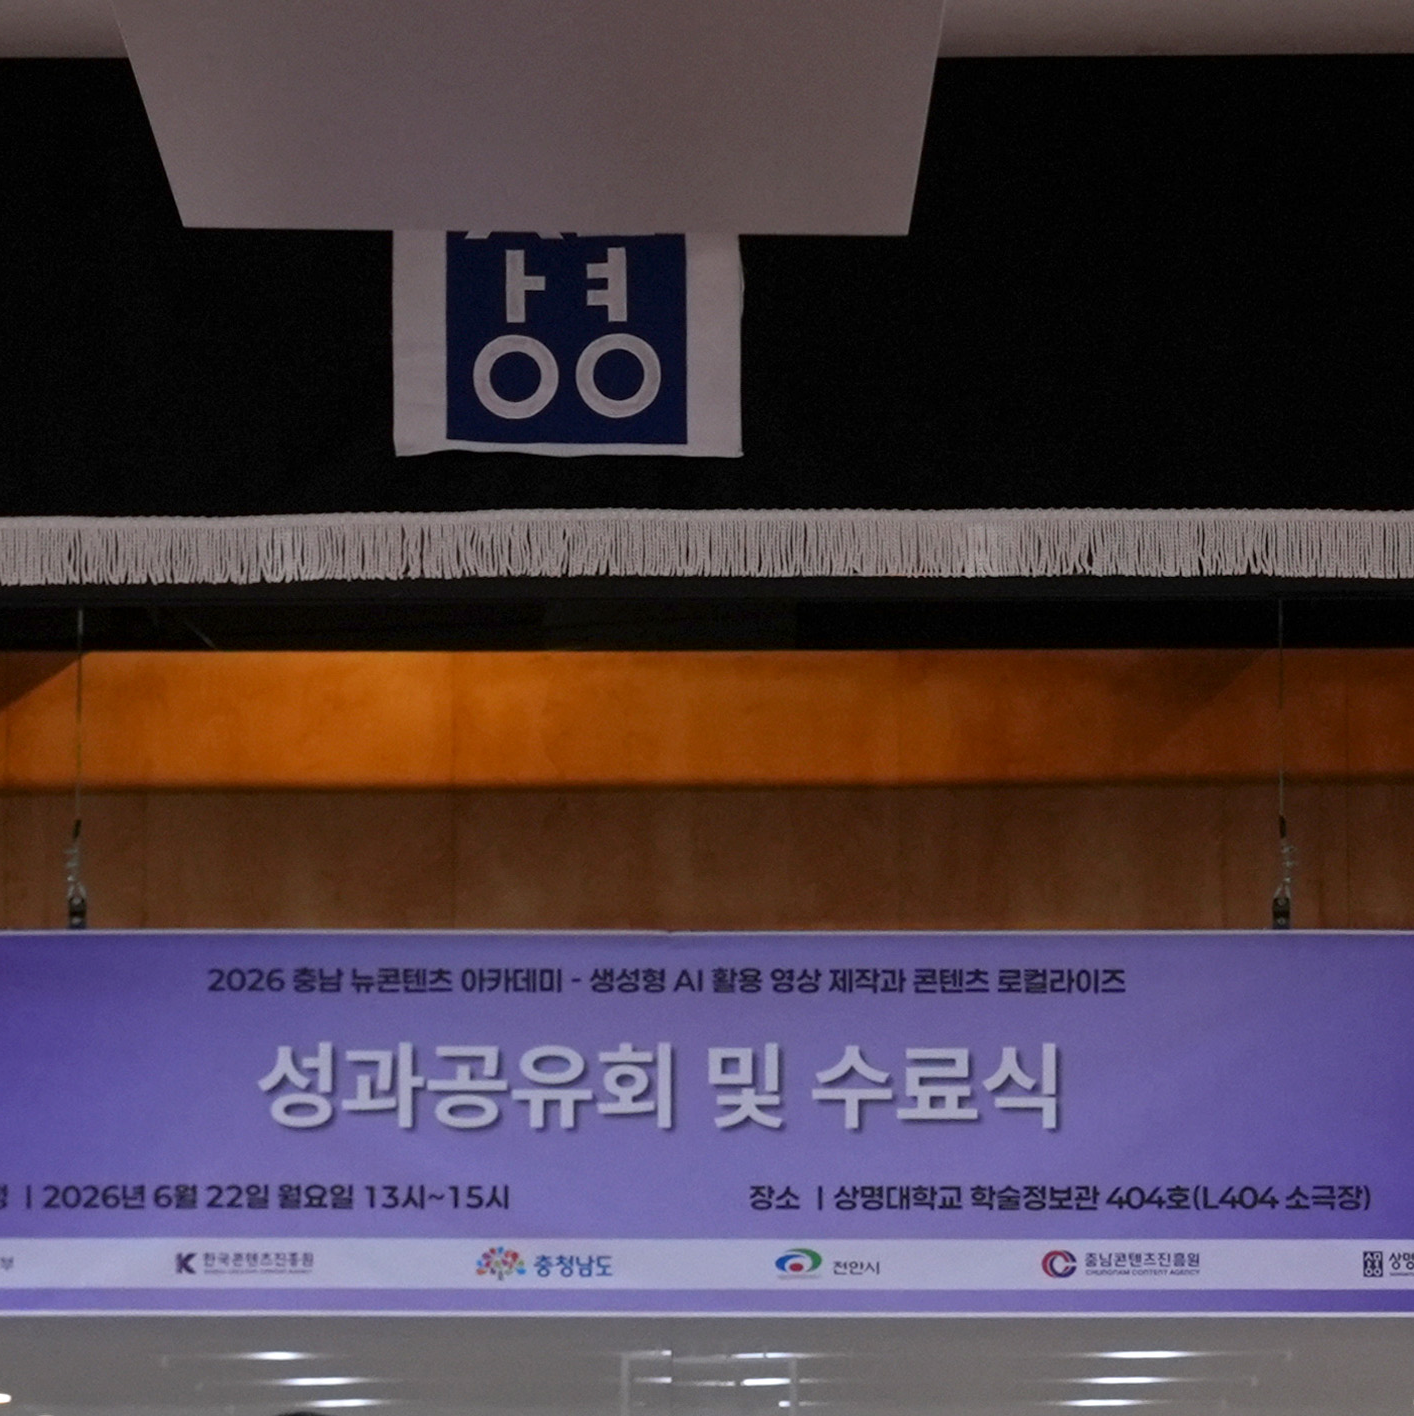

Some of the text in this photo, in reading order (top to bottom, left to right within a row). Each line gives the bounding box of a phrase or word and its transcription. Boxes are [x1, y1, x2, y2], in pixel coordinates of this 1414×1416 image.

[207, 967, 286, 993] 2026
[292, 966, 344, 994] 충남
[350, 967, 453, 994] 뉴콘텐츠
[460, 968, 563, 994] 아카데미
[589, 967, 666, 994] 생성형
[673, 969, 704, 993] AI
[711, 967, 763, 994] 활용
[770, 968, 823, 994] 영상
[828, 968, 907, 994] 제작과
[913, 968, 990, 994] 콘텐츠
[997, 968, 1126, 994] 로컬라이즈
[257, 1041, 1059, 1130] 성과공유회 및 수료식
[42, 1184, 146, 1210] 2026년
[153, 1184, 198, 1210] 6월
[206, 1184, 269, 1210] 22일
[277, 1183, 354, 1210] 월요일
[364, 1184, 510, 1210] 13시~15시
[749, 1185, 801, 1211] 장소
[833, 1184, 963, 1211] 상명대학교
[970, 1185, 1101, 1211] 학술정보관
[1105, 1184, 1280, 1211] 404호(L404
[1285, 1184, 1372, 1211] 소극장)
[175, 1252, 198, 1275] K
[533, 1254, 613, 1278] 충청남도
[1084, 1252, 1201, 1268] 충남콘텐츠진흥원
